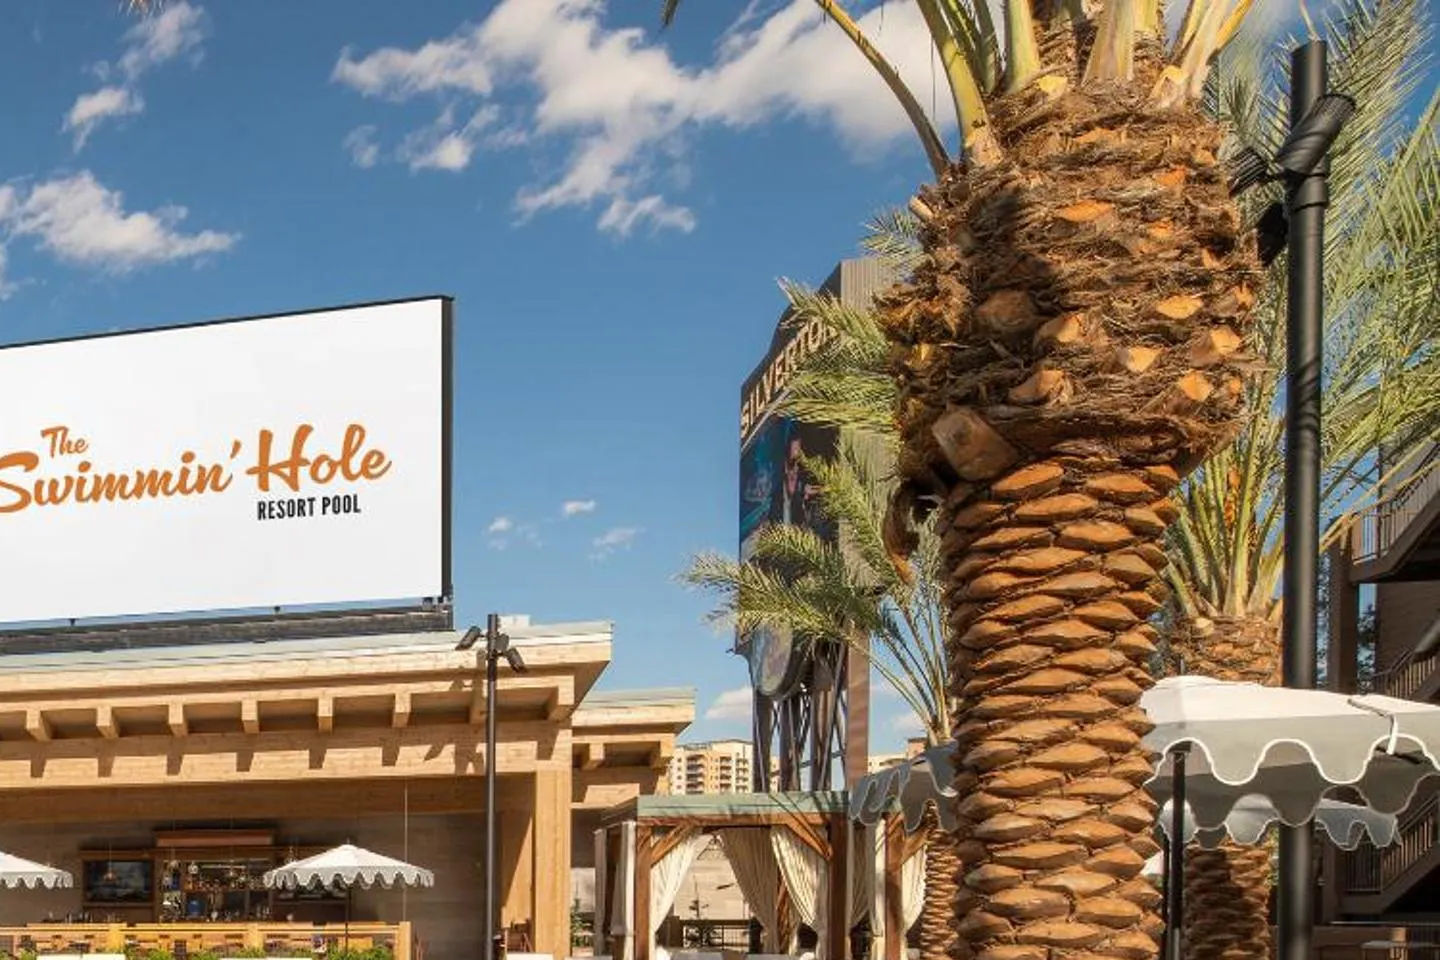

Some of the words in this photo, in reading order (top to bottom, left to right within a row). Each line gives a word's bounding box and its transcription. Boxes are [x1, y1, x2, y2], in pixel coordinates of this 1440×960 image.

[40, 425, 89, 459] The
[245, 423, 393, 493] Hole
[257, 496, 317, 521] RESORT
[321, 493, 362, 516] POOL
